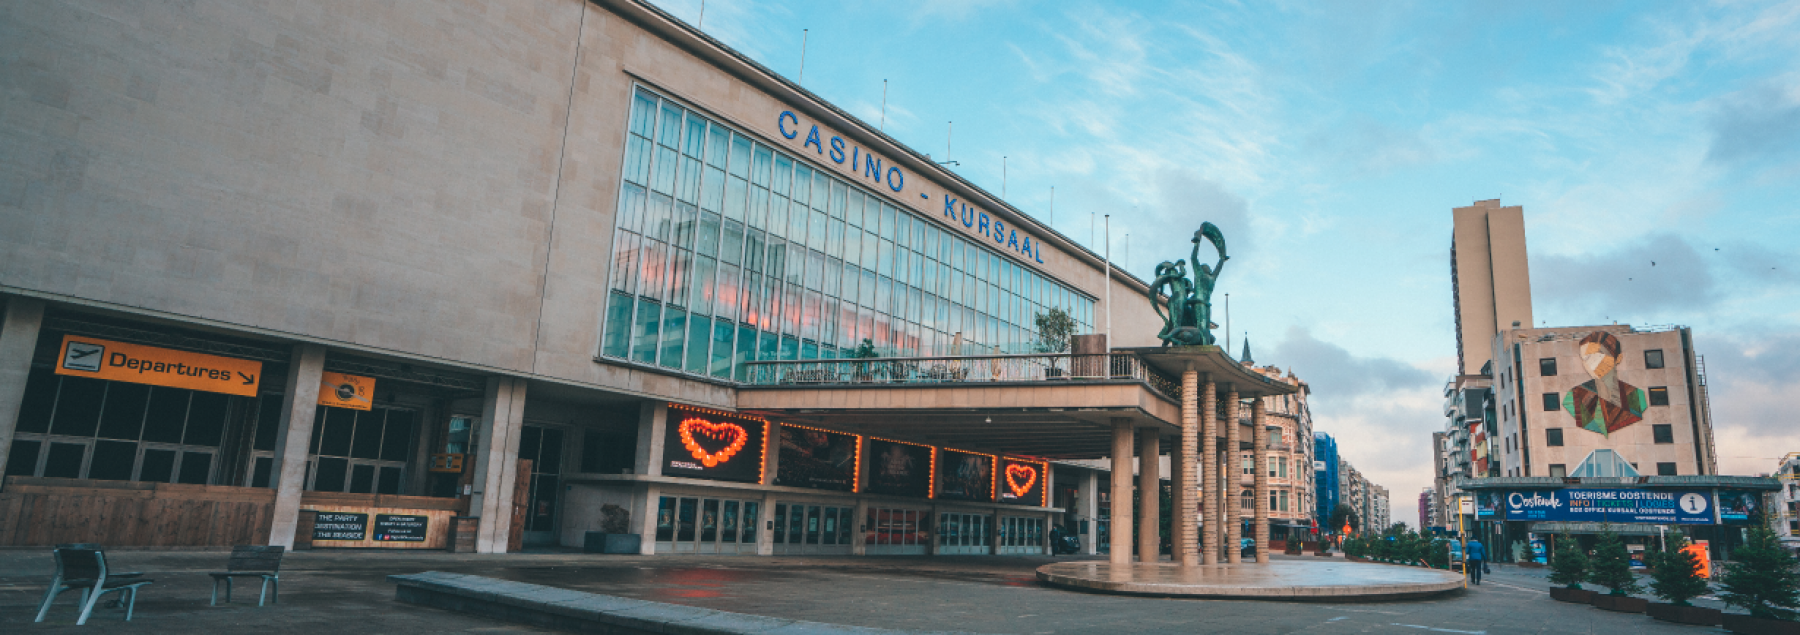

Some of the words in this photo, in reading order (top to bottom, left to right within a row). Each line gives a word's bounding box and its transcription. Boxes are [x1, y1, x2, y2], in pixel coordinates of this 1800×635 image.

[778, 110, 904, 192] CASINO
[944, 194, 1044, 264] KURSAAL
[109, 351, 231, 381] Departures
[1569, 491, 1617, 500] TOERISME
[1619, 491, 1675, 500] OOSTENDE
[1597, 500, 1634, 508] TICKETS
[334, 514, 358, 522] PARTY
